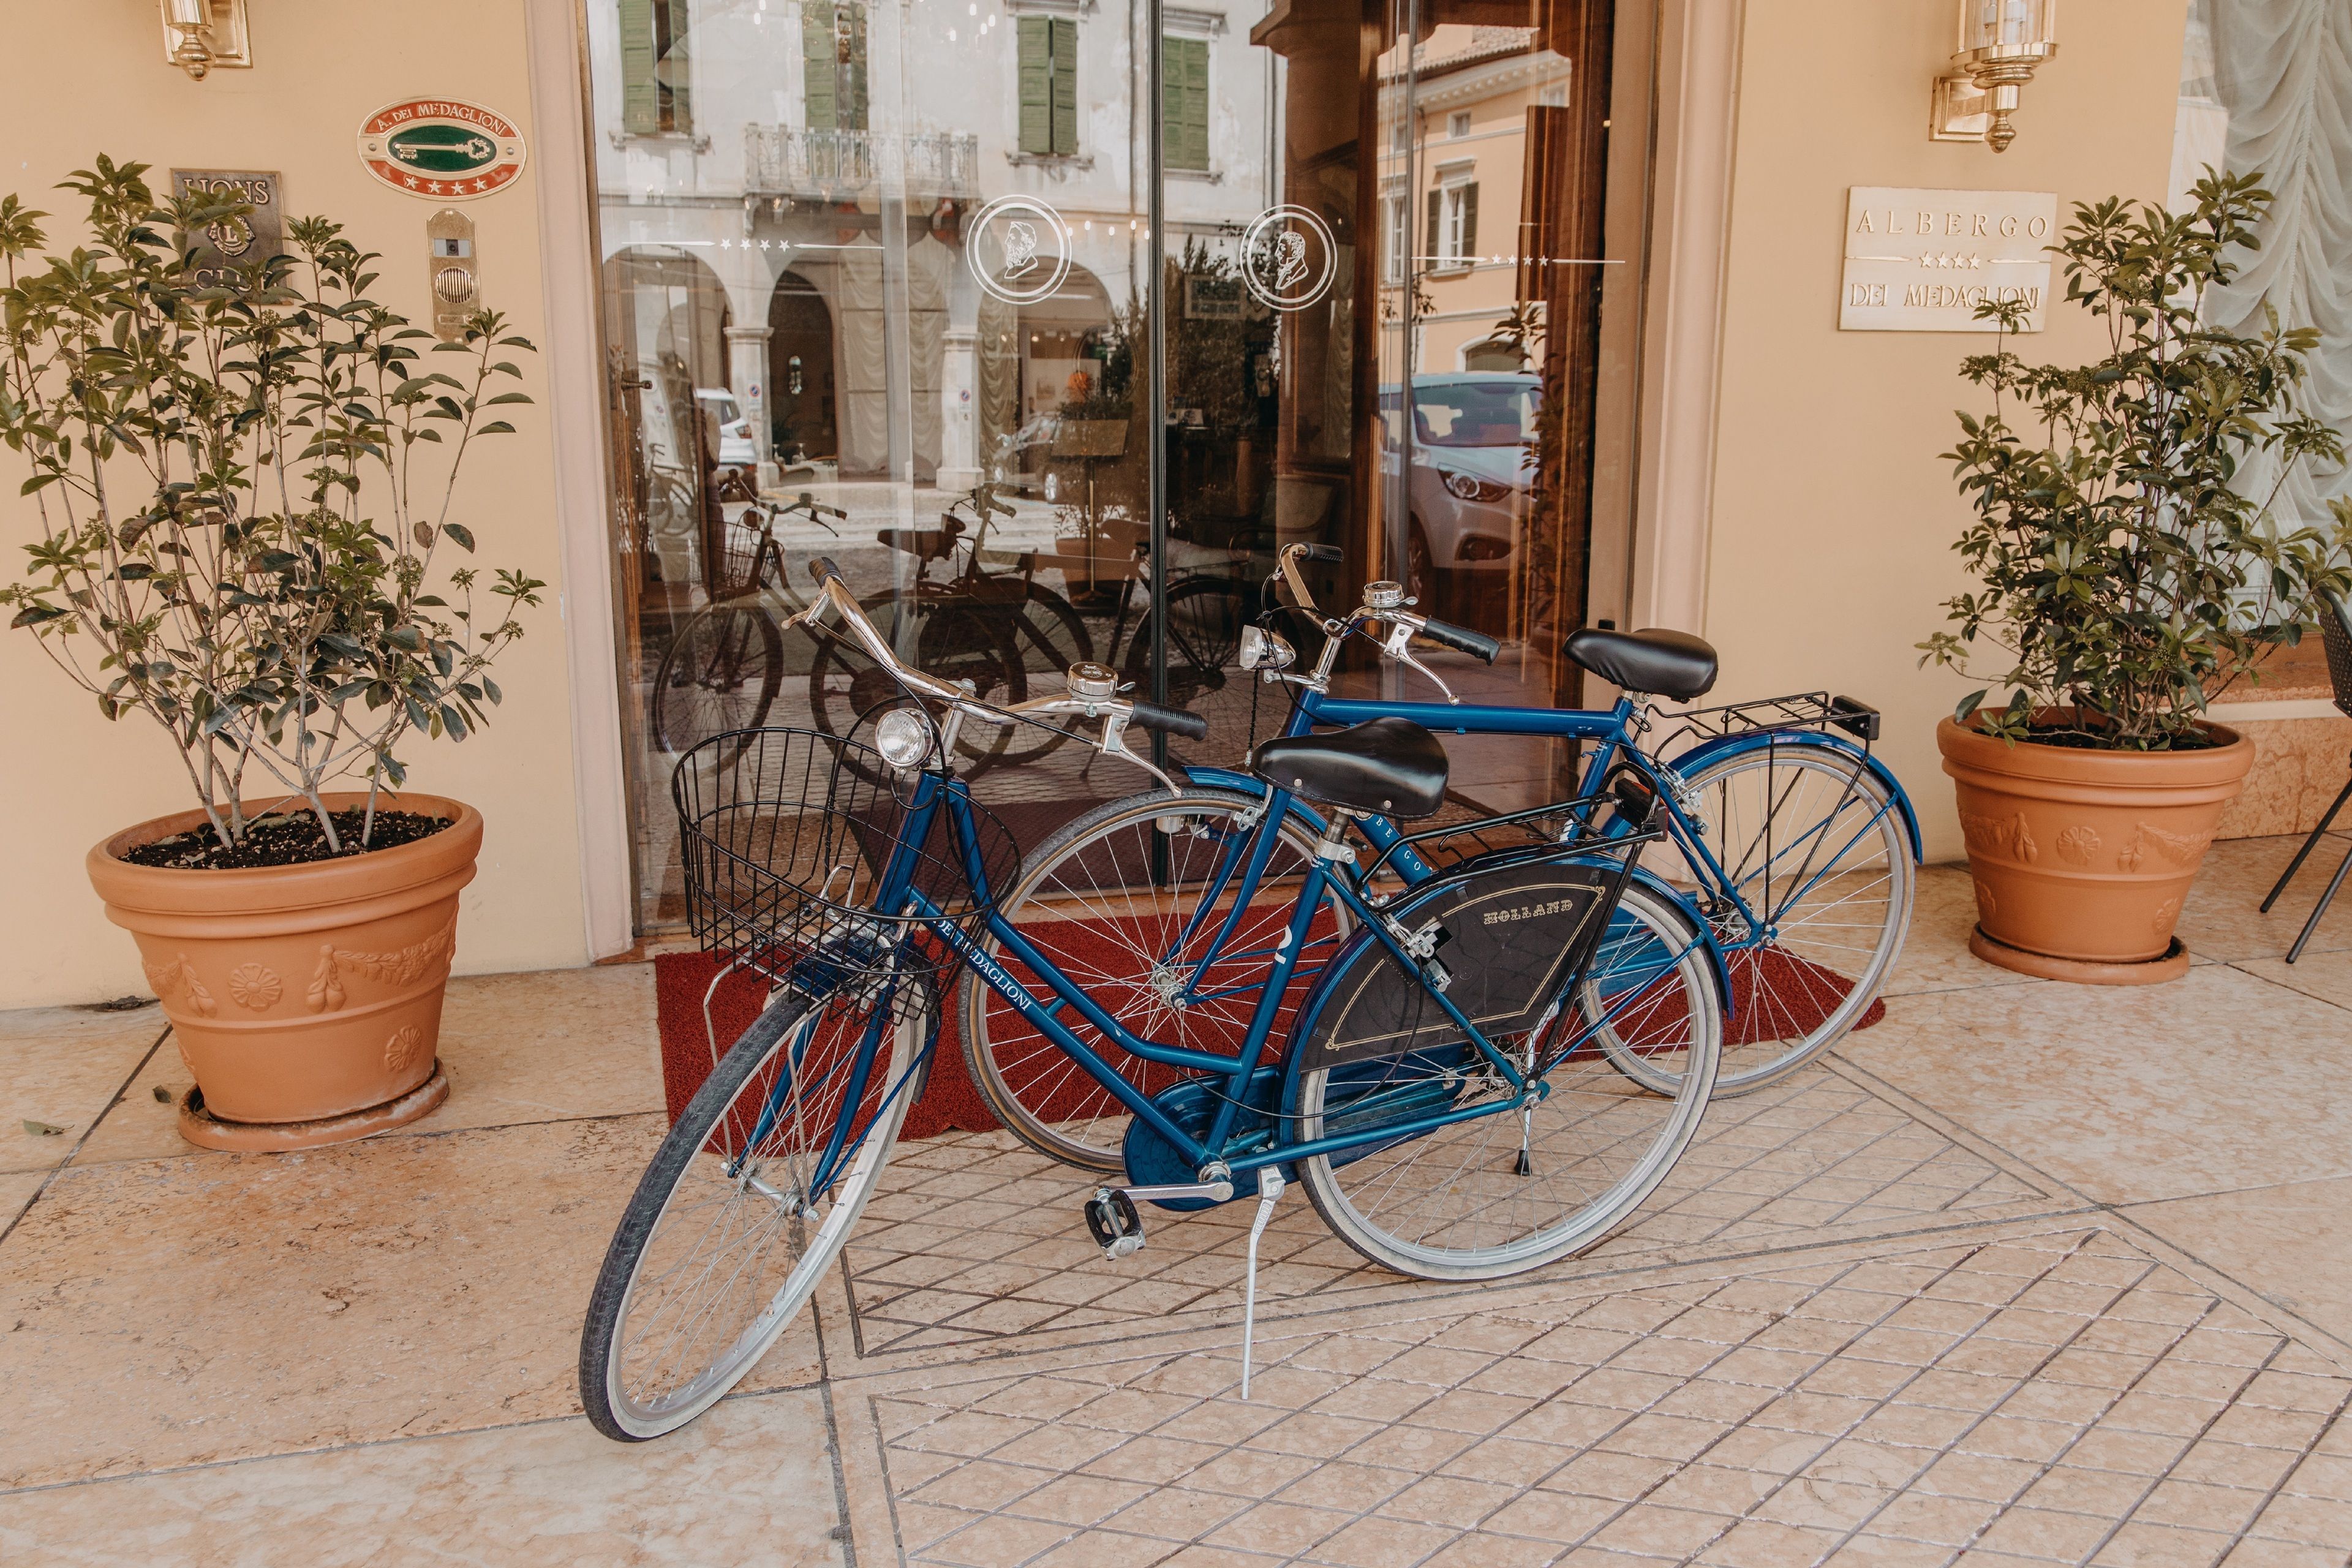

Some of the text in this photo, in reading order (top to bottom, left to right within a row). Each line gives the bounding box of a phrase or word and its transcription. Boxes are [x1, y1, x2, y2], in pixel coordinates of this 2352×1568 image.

[376, 103, 508, 135] A. DEI MEDAGLIONI
[1856, 209, 2048, 238] ALBERGO
[1850, 283, 2041, 309] DEI MEDAGLIONI
[1376, 817, 1422, 870] BEGO
[1483, 899, 1573, 925] HOLLAND
